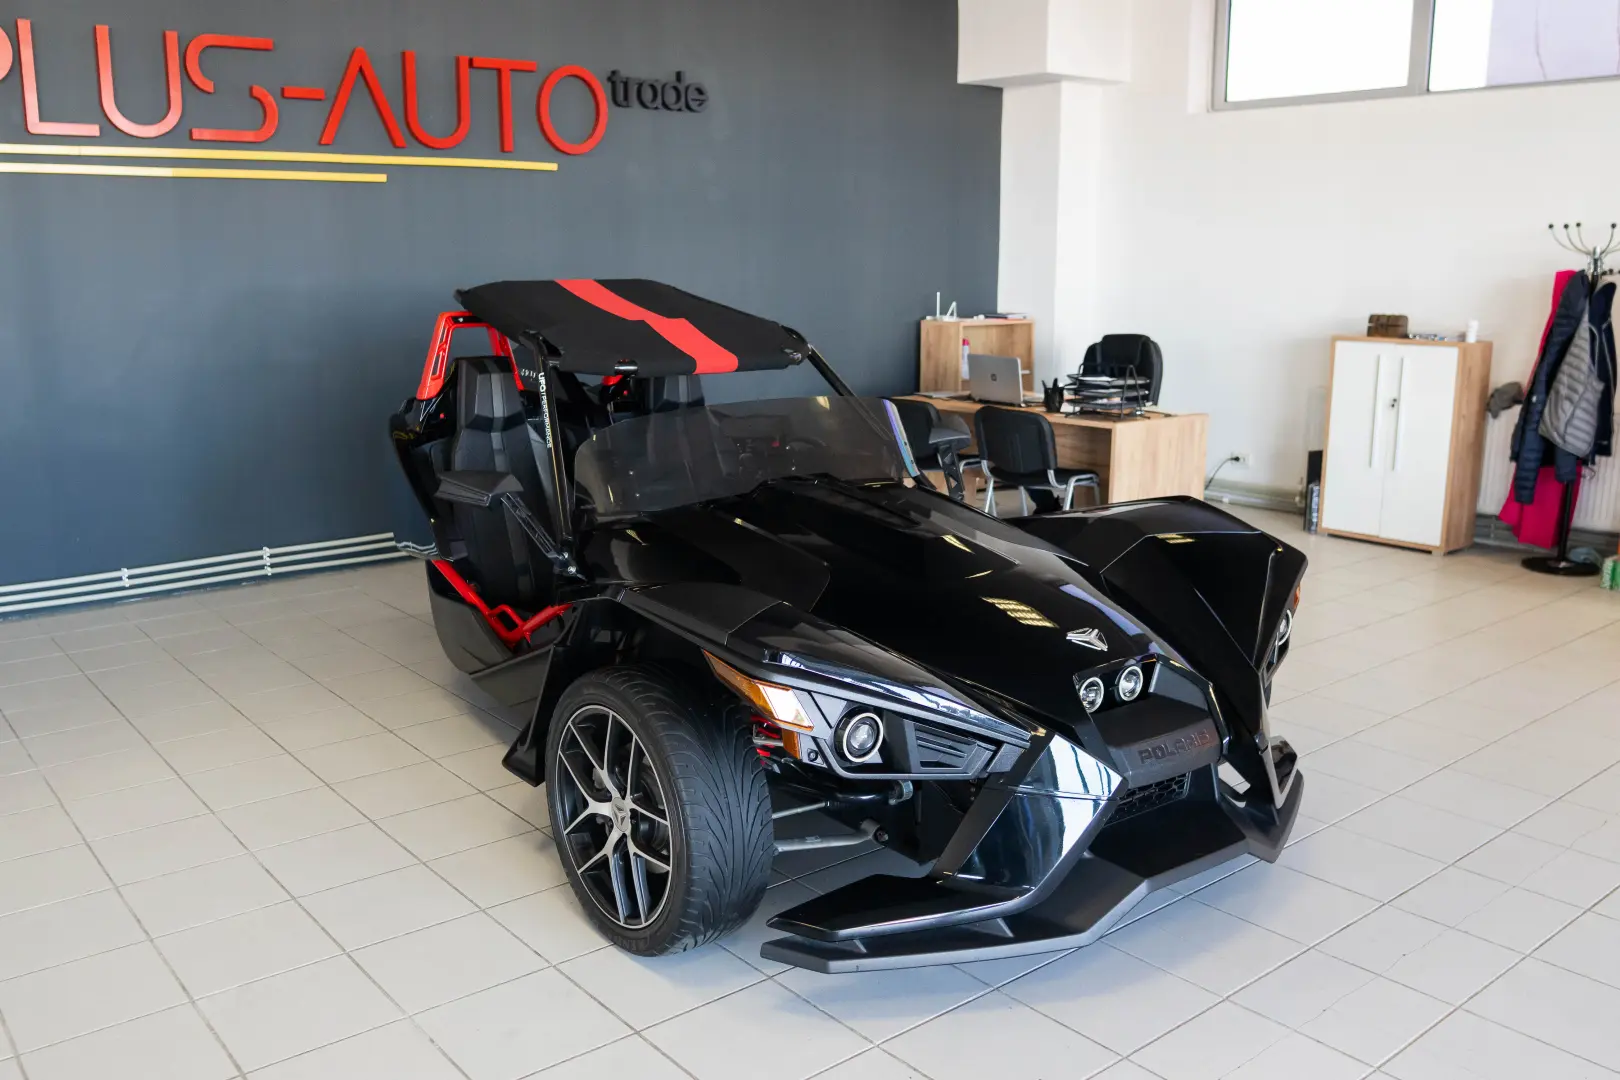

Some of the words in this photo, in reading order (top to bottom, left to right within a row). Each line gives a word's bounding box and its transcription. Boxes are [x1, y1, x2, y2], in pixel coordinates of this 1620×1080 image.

[0, 18, 609, 155] LUS-AUTO
[606, 70, 708, 113] trade
[538, 372, 546, 393] UFO
[1138, 729, 1210, 764] POLARIS
